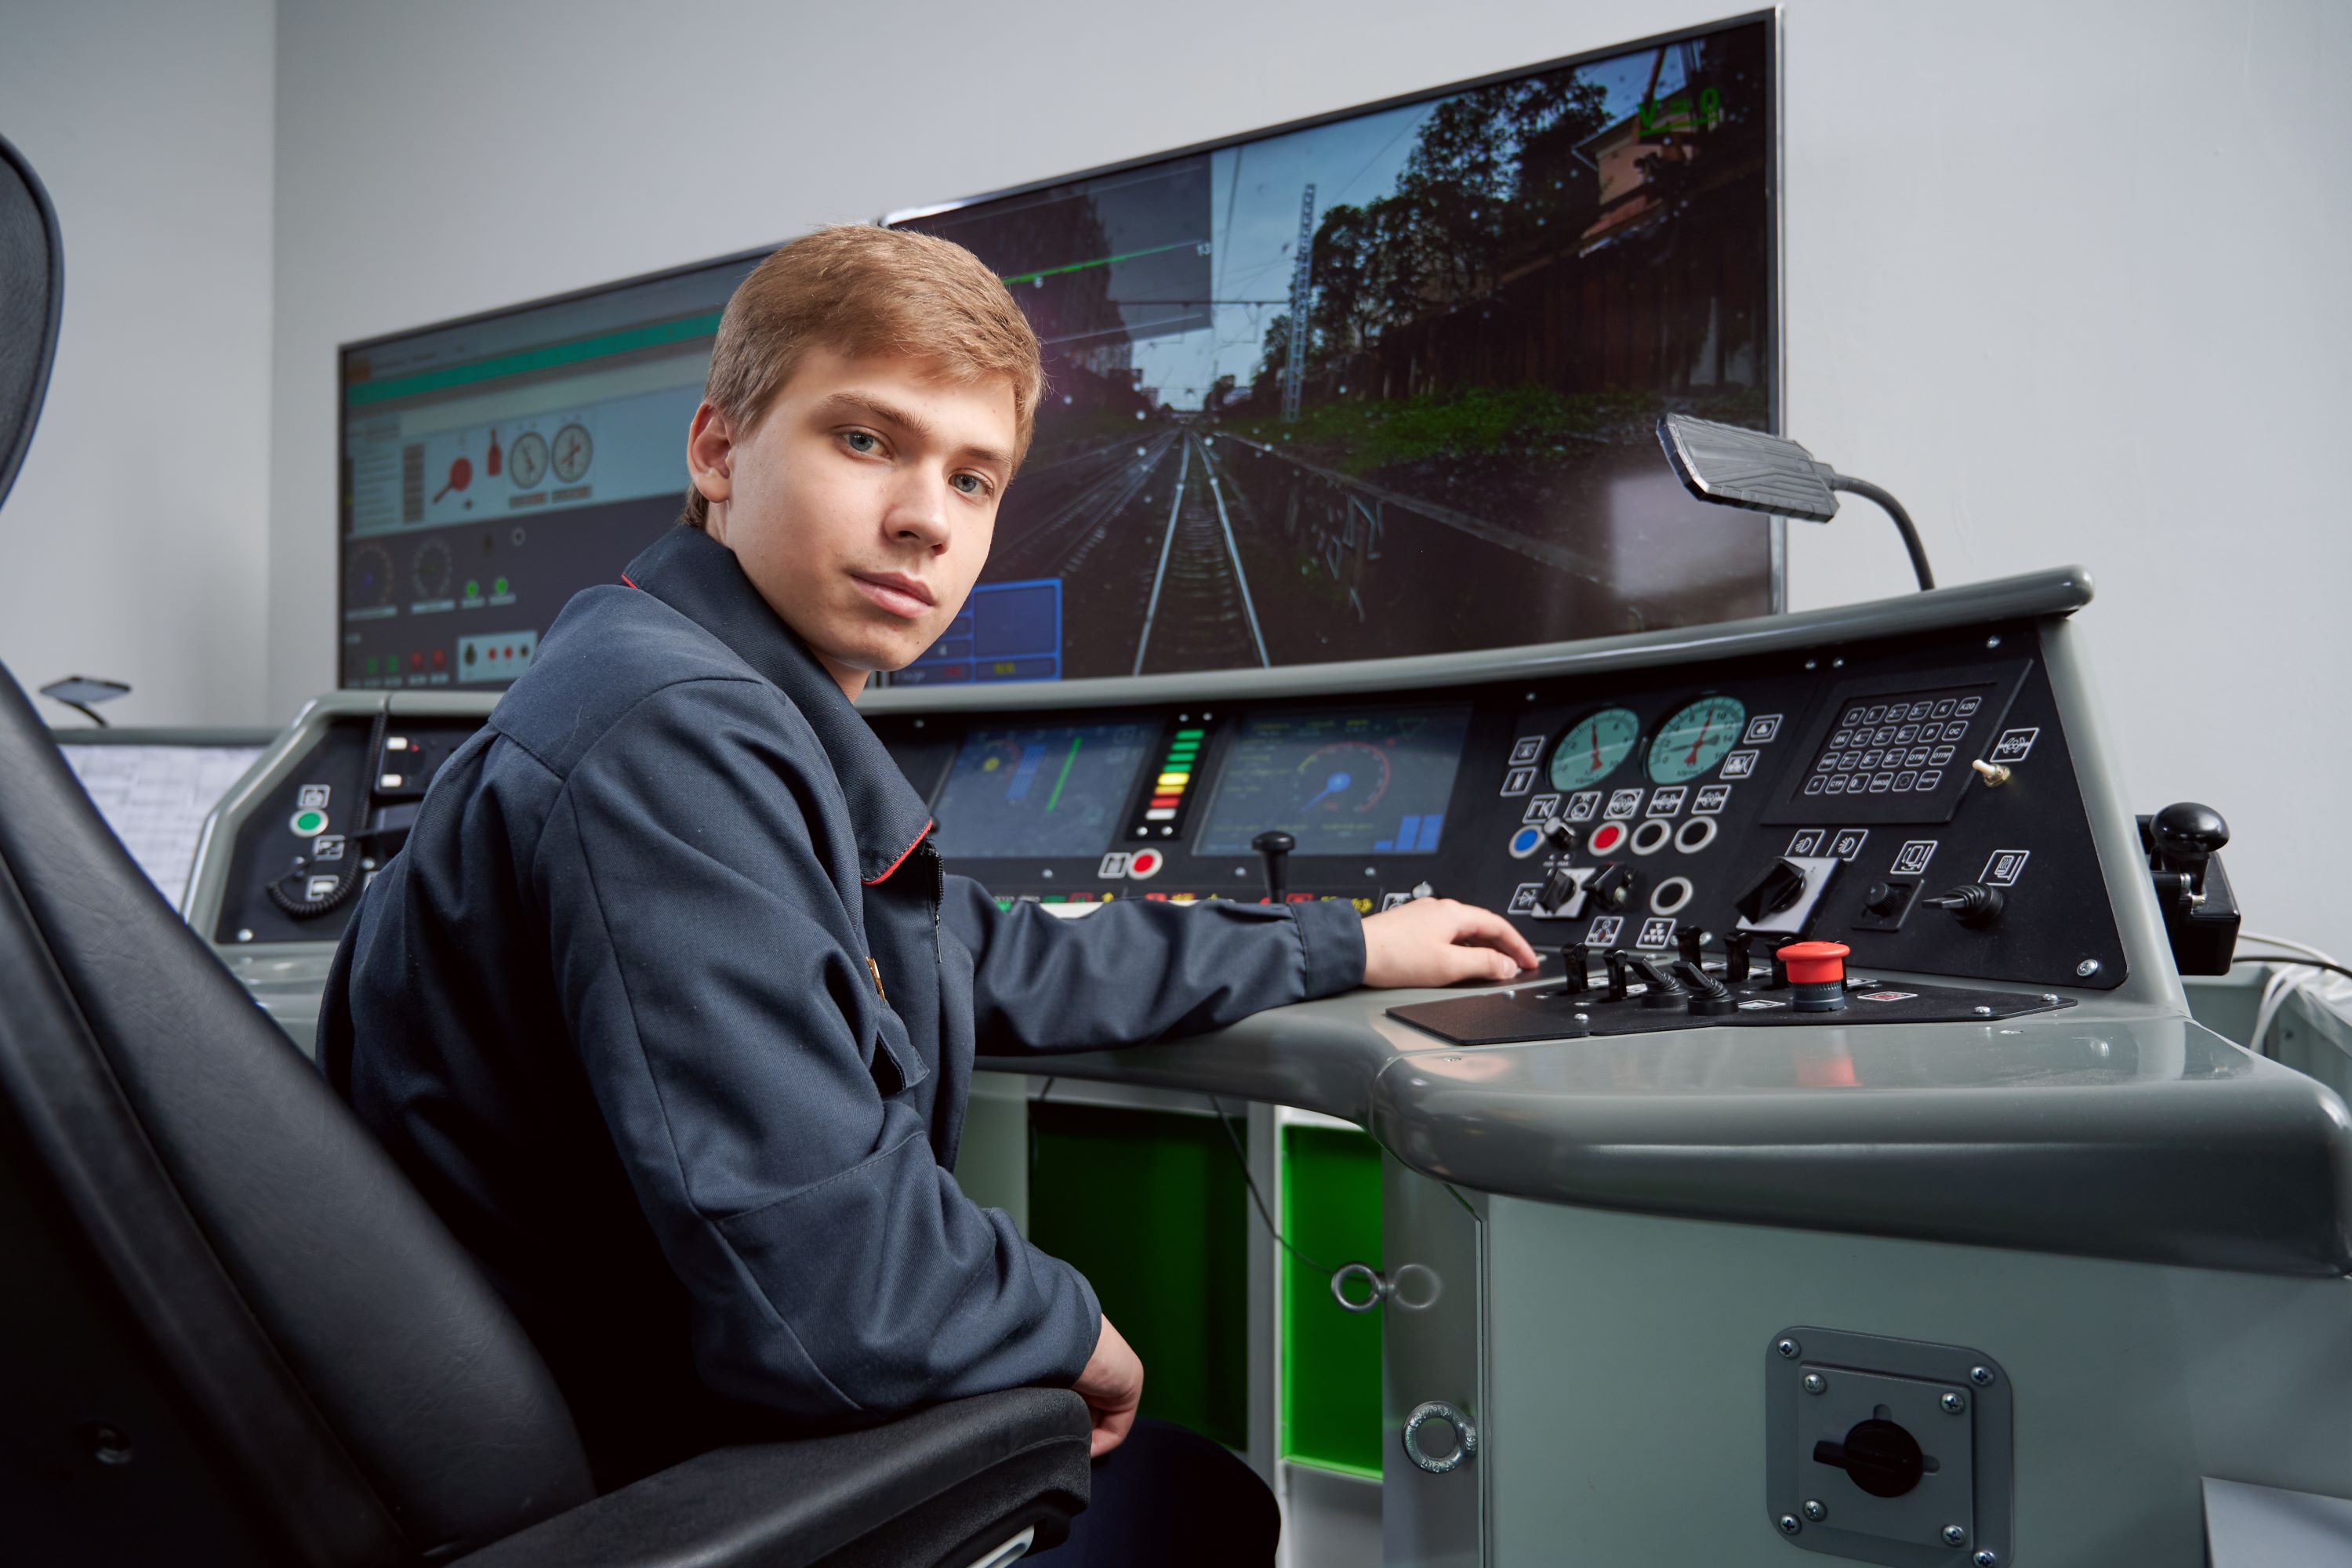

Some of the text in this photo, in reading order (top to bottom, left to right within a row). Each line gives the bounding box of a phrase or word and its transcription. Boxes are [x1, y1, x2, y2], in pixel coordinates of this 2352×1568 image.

[1636, 100, 1659, 127] V
[1700, 87, 1719, 114] 0
[1527, 800, 1555, 817] ГК
